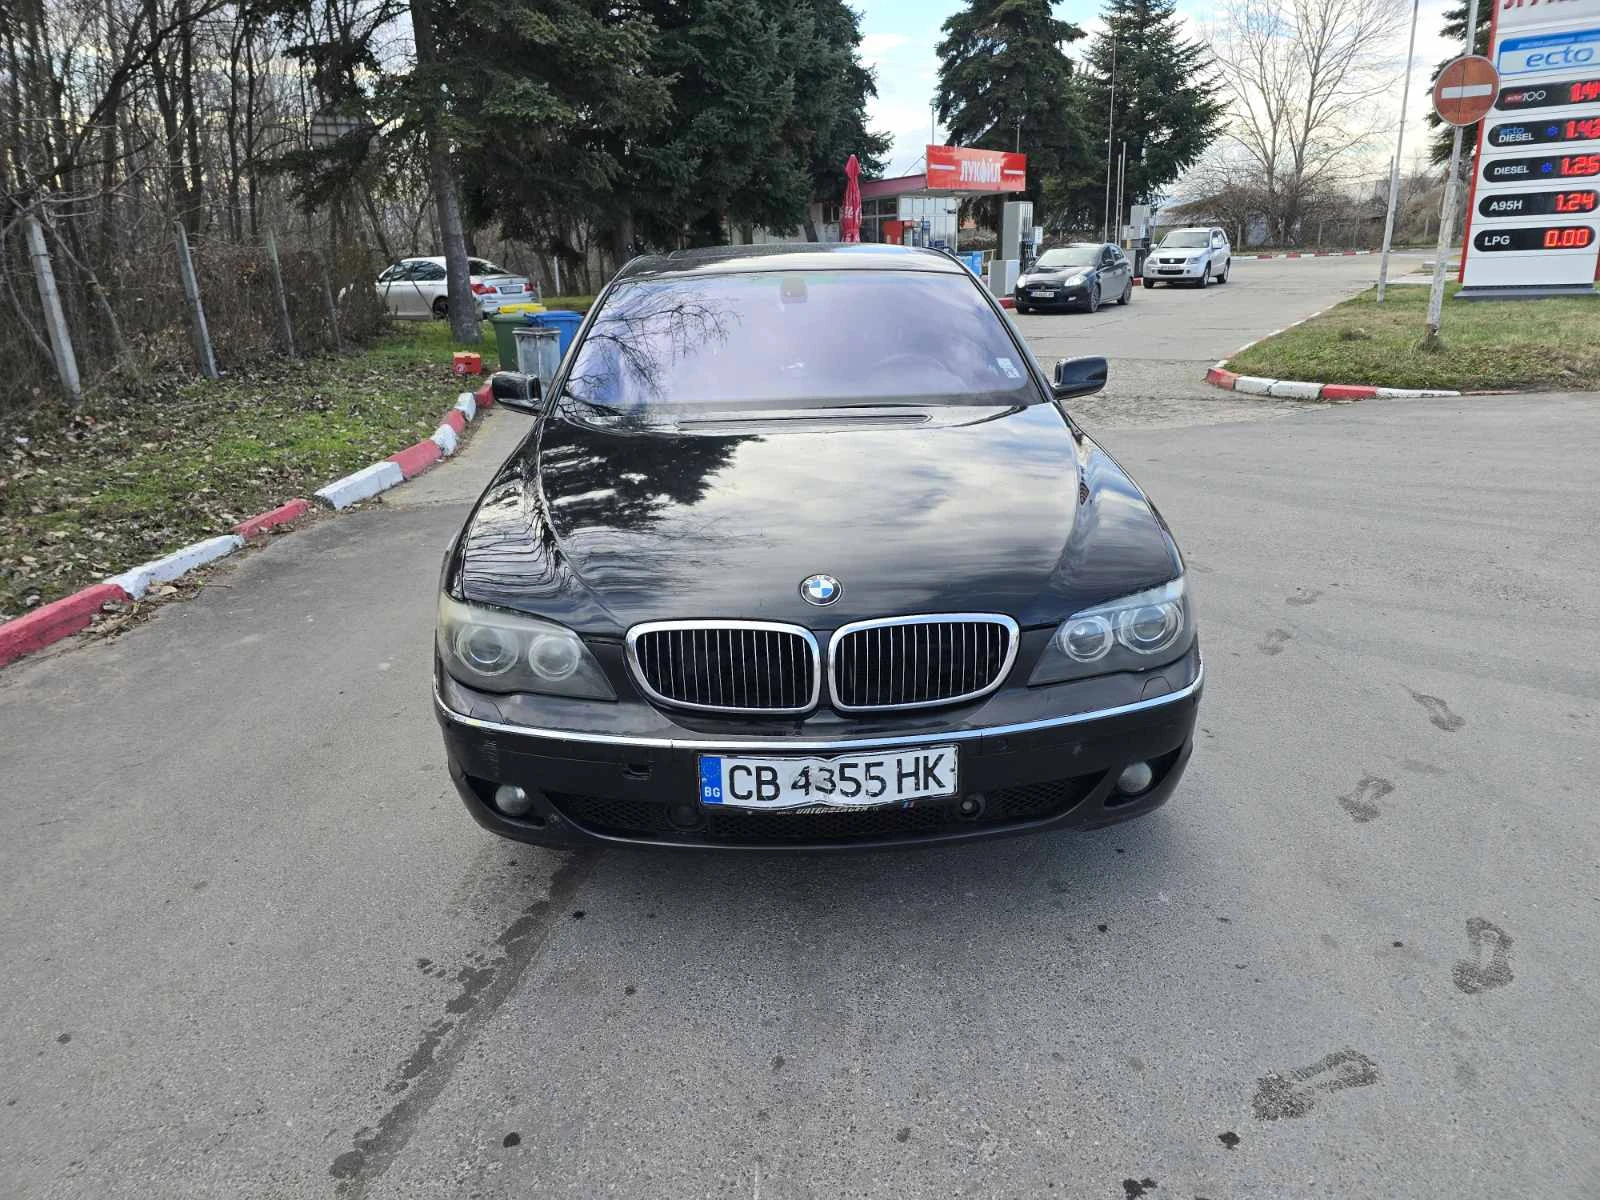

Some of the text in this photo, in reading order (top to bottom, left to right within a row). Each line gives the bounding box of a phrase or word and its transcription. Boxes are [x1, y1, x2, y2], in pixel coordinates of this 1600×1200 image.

[1526, 46, 1594, 67] ecto
[1498, 132, 1535, 143] DIESEL
[1493, 155, 1600, 176] DIESEL 1.25
[1489, 192, 1595, 212] A95H 1.24
[1484, 228, 1590, 247] LPG 0.00
[729, 754, 946, 800] CB 4355 HK
[704, 786, 721, 798] BG
